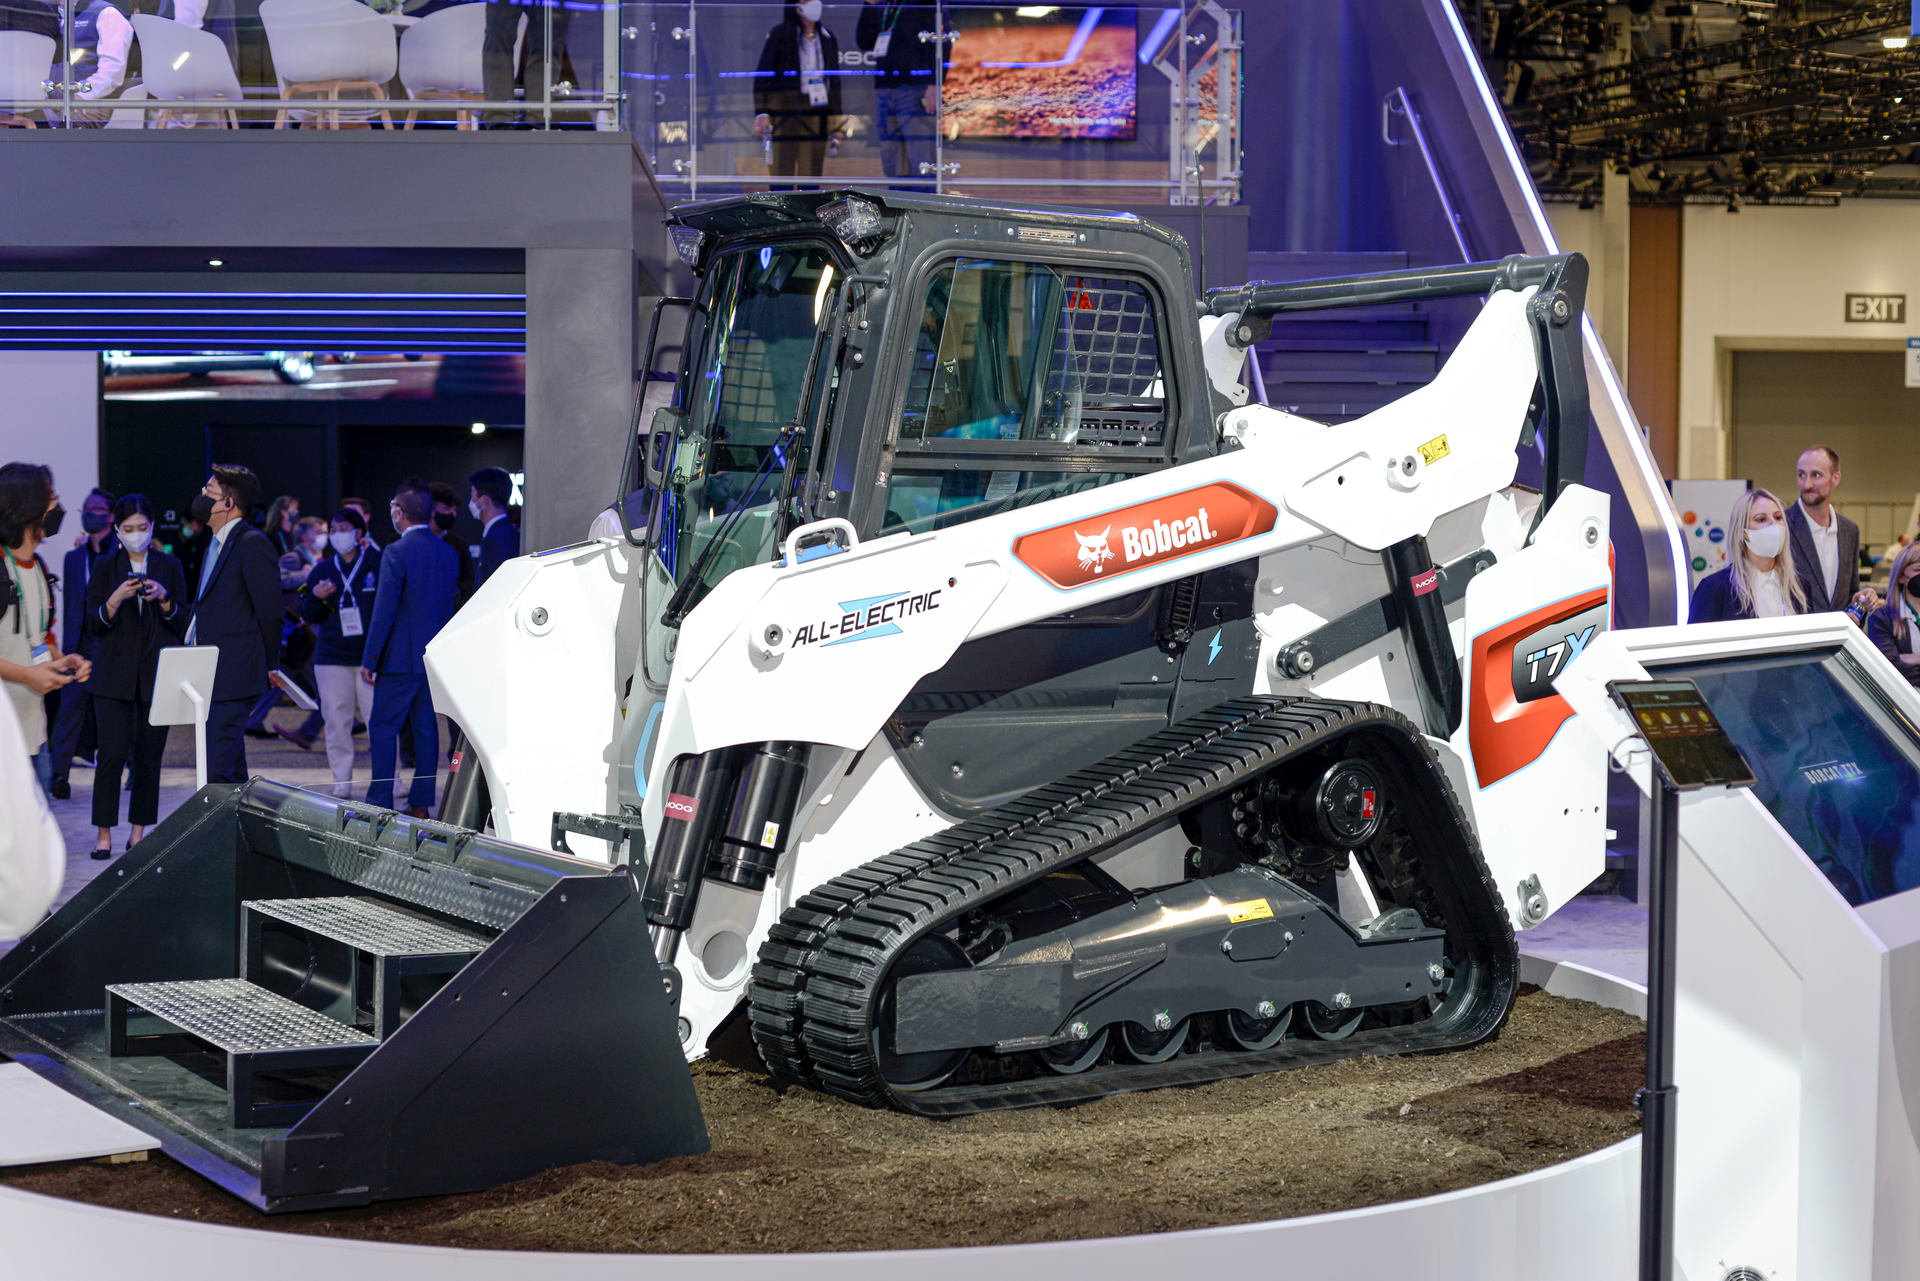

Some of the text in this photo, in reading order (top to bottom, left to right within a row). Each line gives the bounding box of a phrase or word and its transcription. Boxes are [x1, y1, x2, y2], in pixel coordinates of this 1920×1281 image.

[1095, 116, 1109, 125] with
[1850, 296, 1904, 321] EXIT
[1121, 507, 1212, 563] Bobcat
[790, 588, 943, 650] ALL-ELECTRIC
[1803, 761, 1864, 785] BOBCAT T7X
